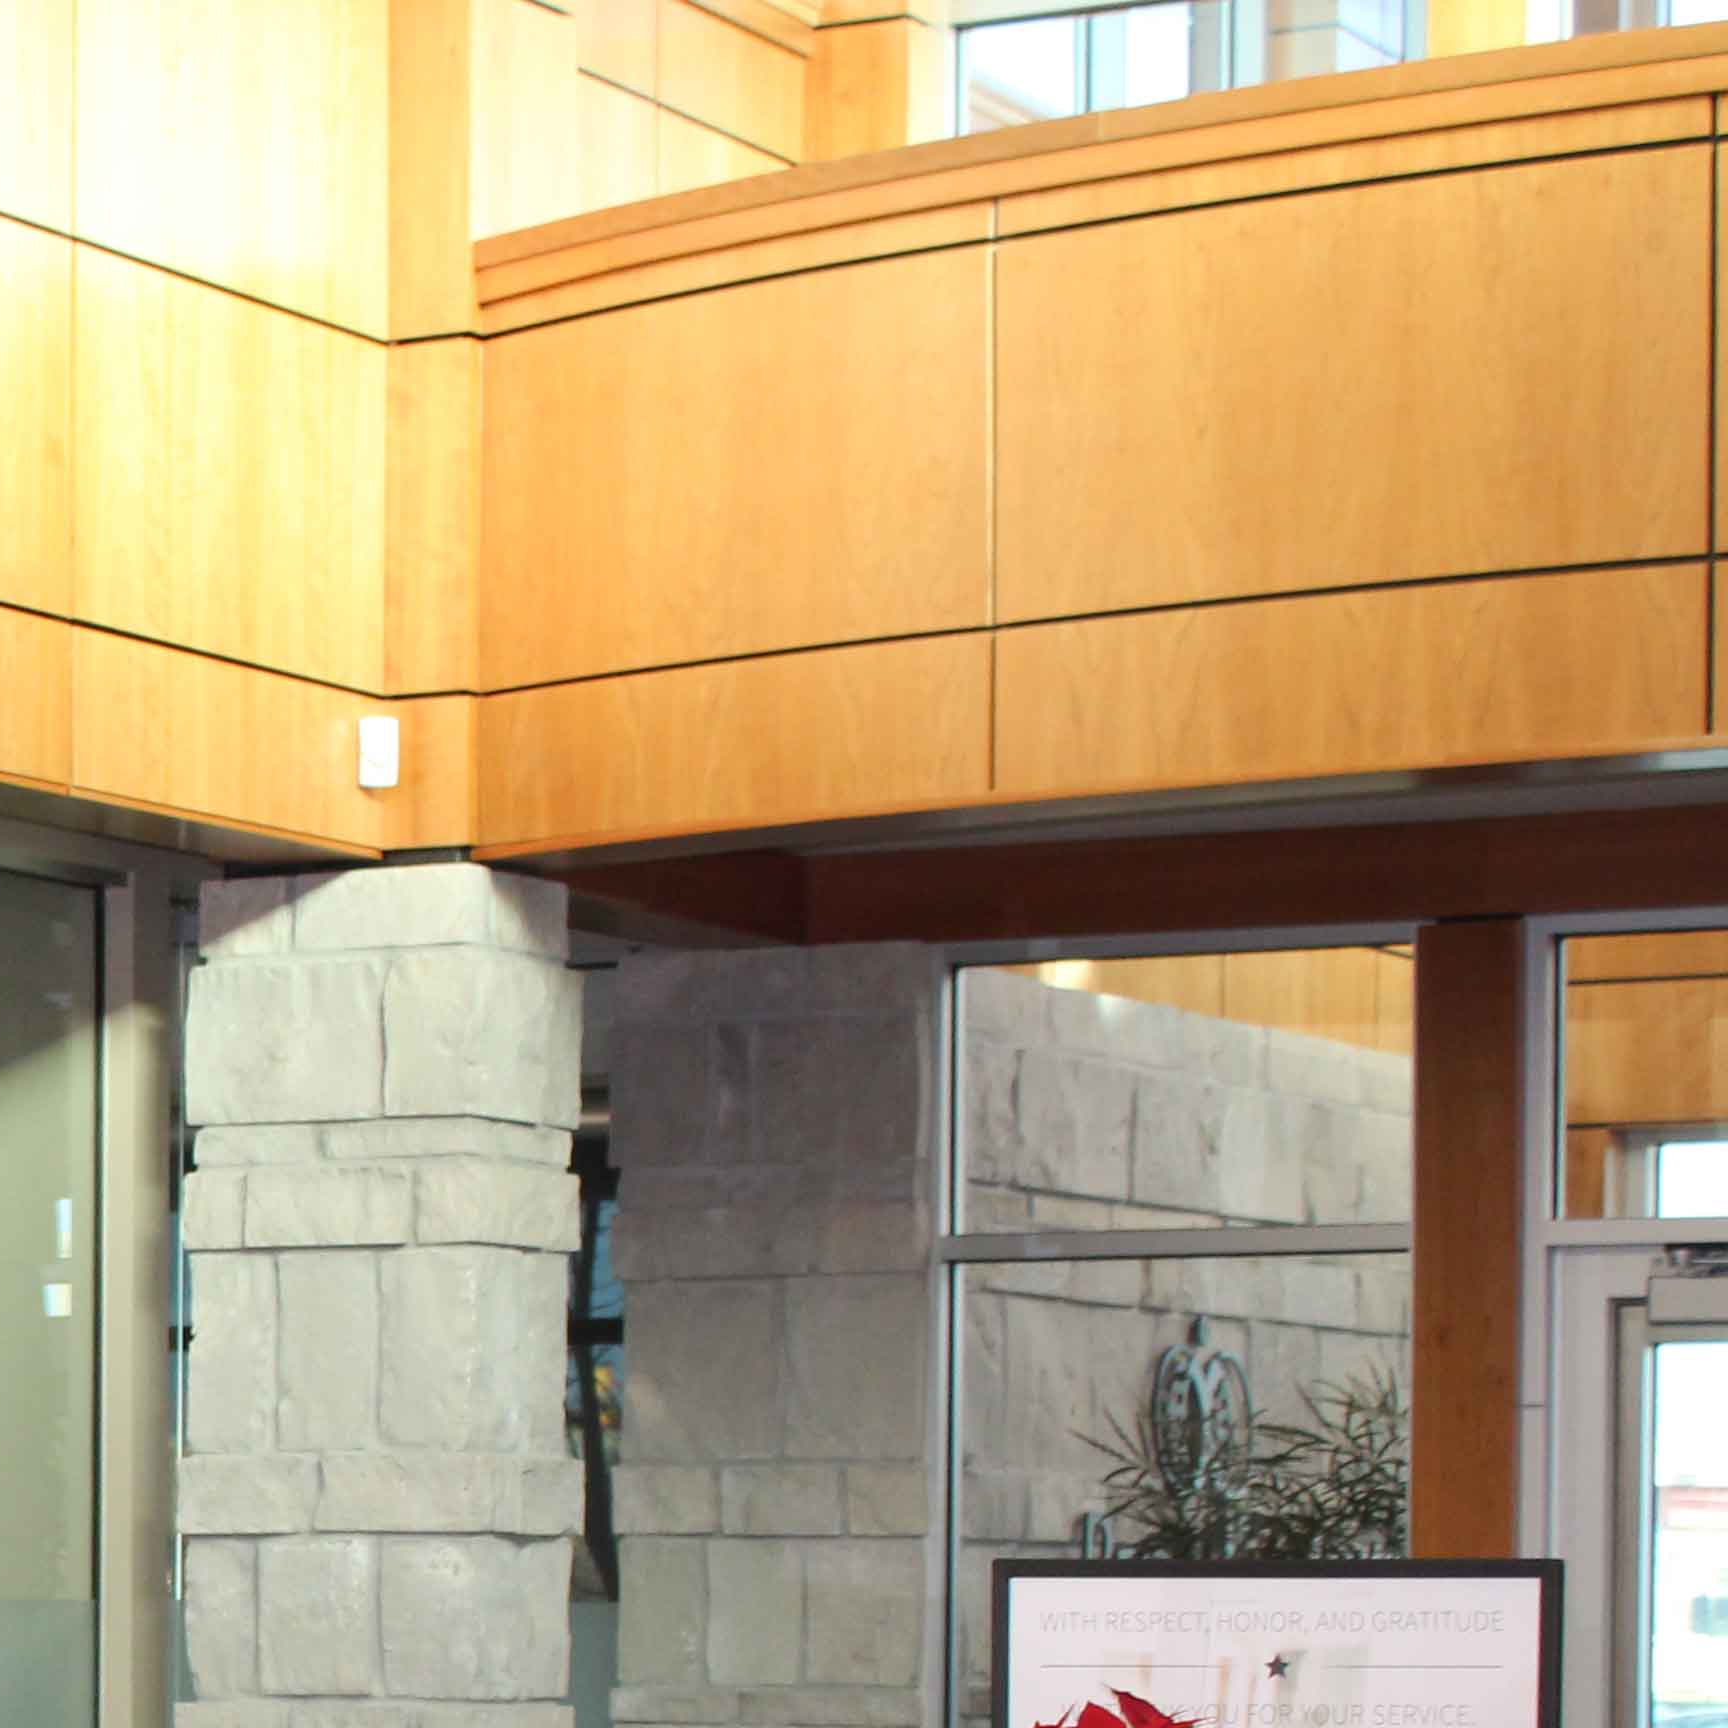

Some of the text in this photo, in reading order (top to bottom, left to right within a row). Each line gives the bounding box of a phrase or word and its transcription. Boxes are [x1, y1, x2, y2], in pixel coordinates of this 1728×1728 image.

[1040, 1610, 1504, 1636] WITH RESPECT, HONOR, AND GRATITUDE
[1247, 1704, 1292, 1726] FOR
[1300, 1704, 1365, 1726] YOUR
[1372, 1703, 1477, 1727] SERVICE.
